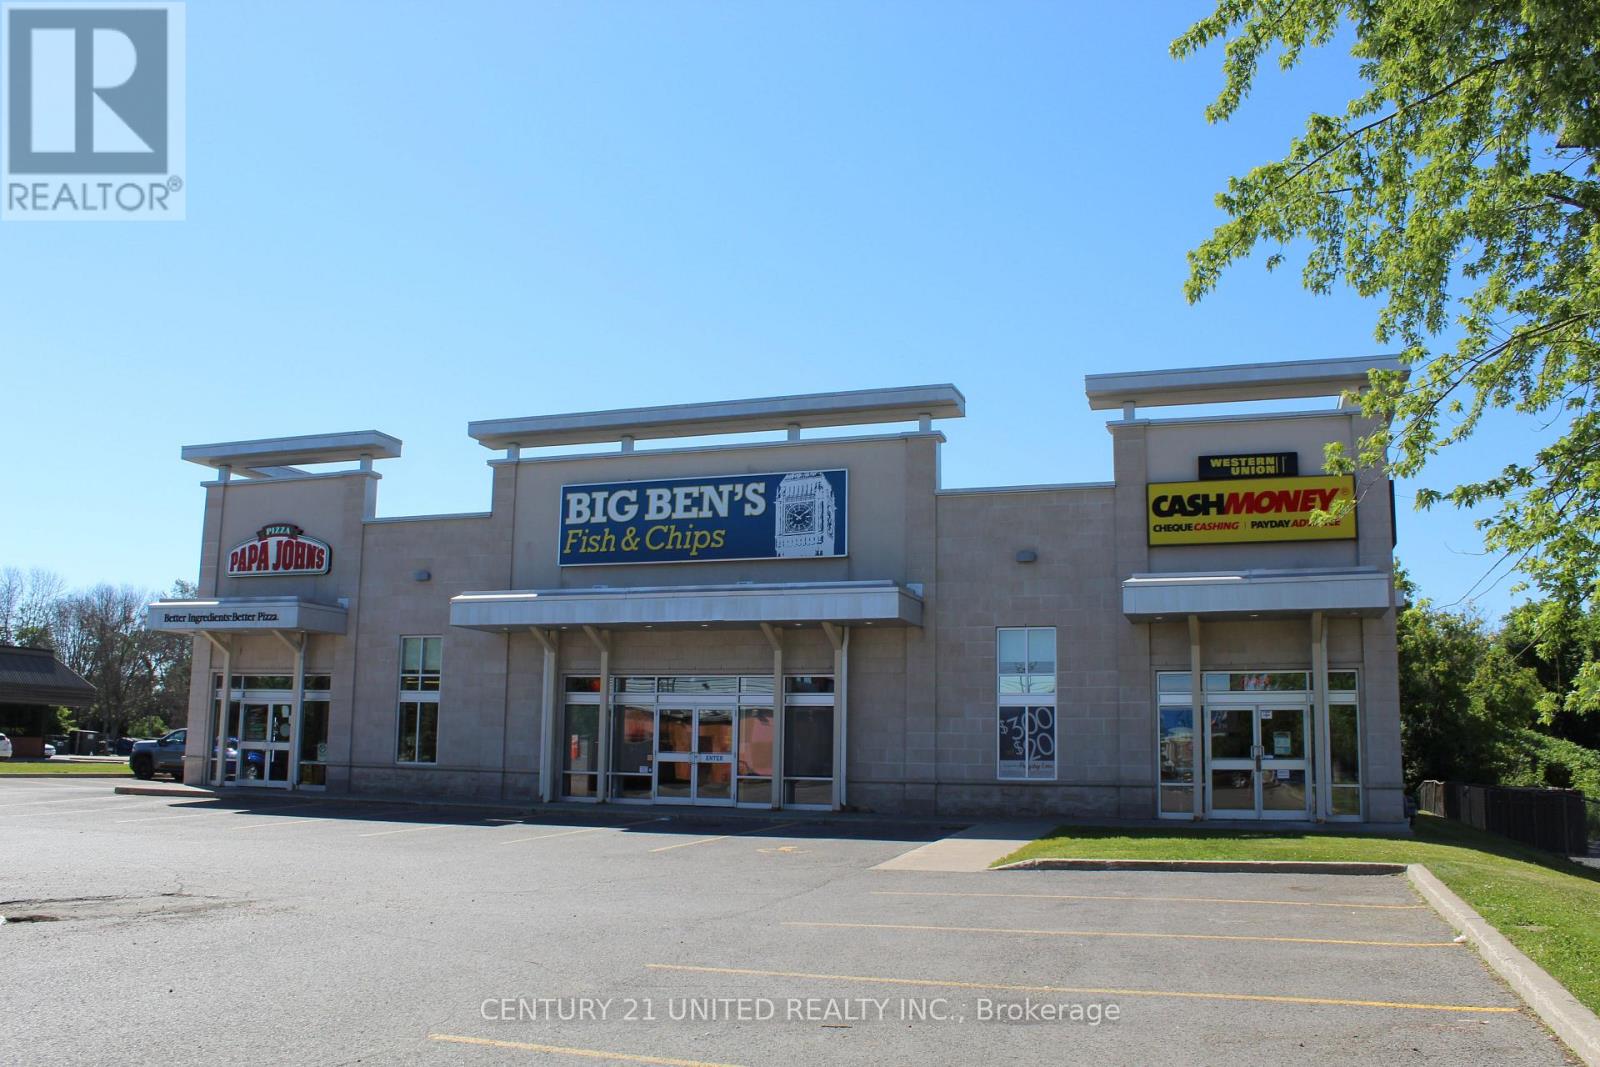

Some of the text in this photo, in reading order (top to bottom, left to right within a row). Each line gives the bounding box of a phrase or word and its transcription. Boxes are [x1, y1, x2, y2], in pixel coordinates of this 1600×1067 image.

[1210, 456, 1275, 468] WESTERN
[1231, 465, 1275, 476] UNION
[565, 481, 766, 525] BIG BEN'S
[265, 526, 290, 535] PIZZA
[1153, 522, 1193, 533] CHEQUE
[1194, 521, 1240, 531] CASHING
[1251, 519, 1290, 529] PAYDAY
[563, 524, 726, 556] Fish & Chips
[229, 540, 269, 572] PAPA
[164, 613, 187, 623] Better
[232, 612, 256, 622] Better
